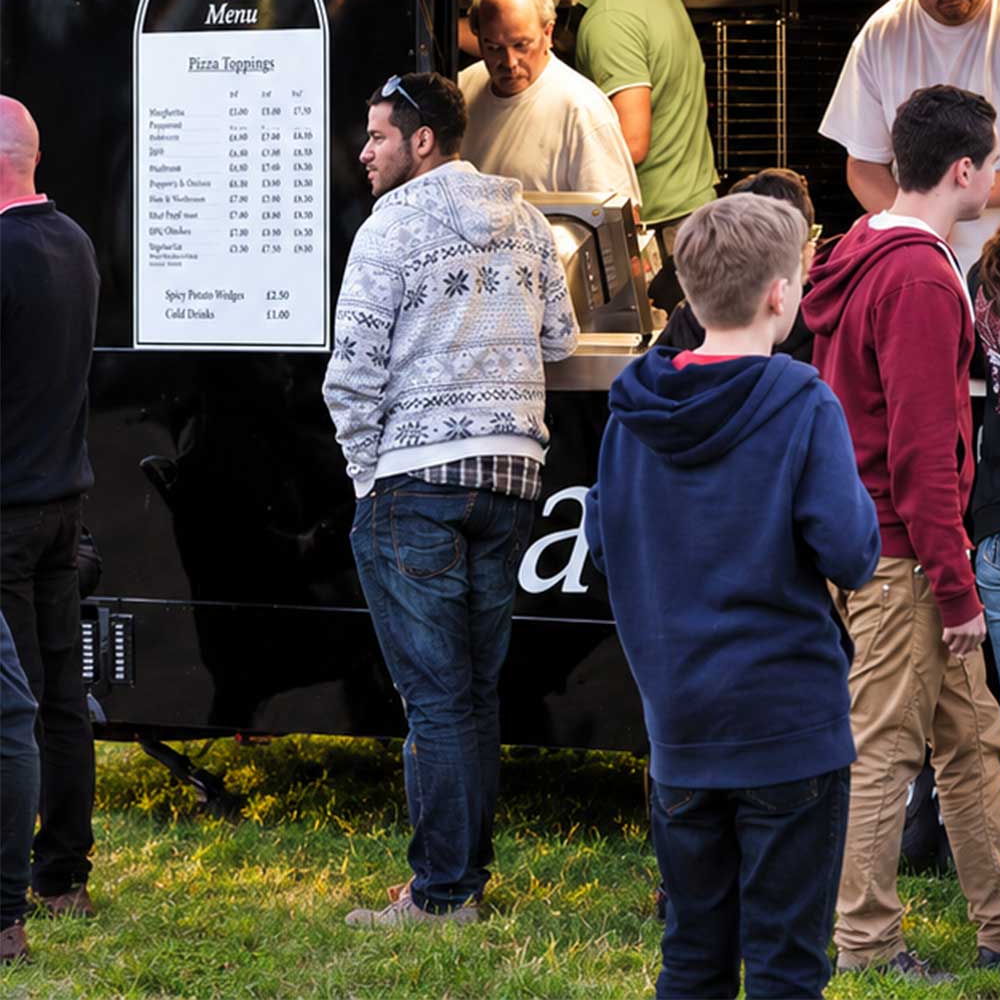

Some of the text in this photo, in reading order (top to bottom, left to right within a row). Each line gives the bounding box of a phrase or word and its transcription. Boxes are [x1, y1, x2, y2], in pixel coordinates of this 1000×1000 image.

[205, 3, 258, 25] Menu
[188, 56, 275, 74] Pizza Toppings
[165, 289, 289, 303] Spicy Potato Wedges £2.50
[165, 308, 290, 319] Cold Drinks £1.00
